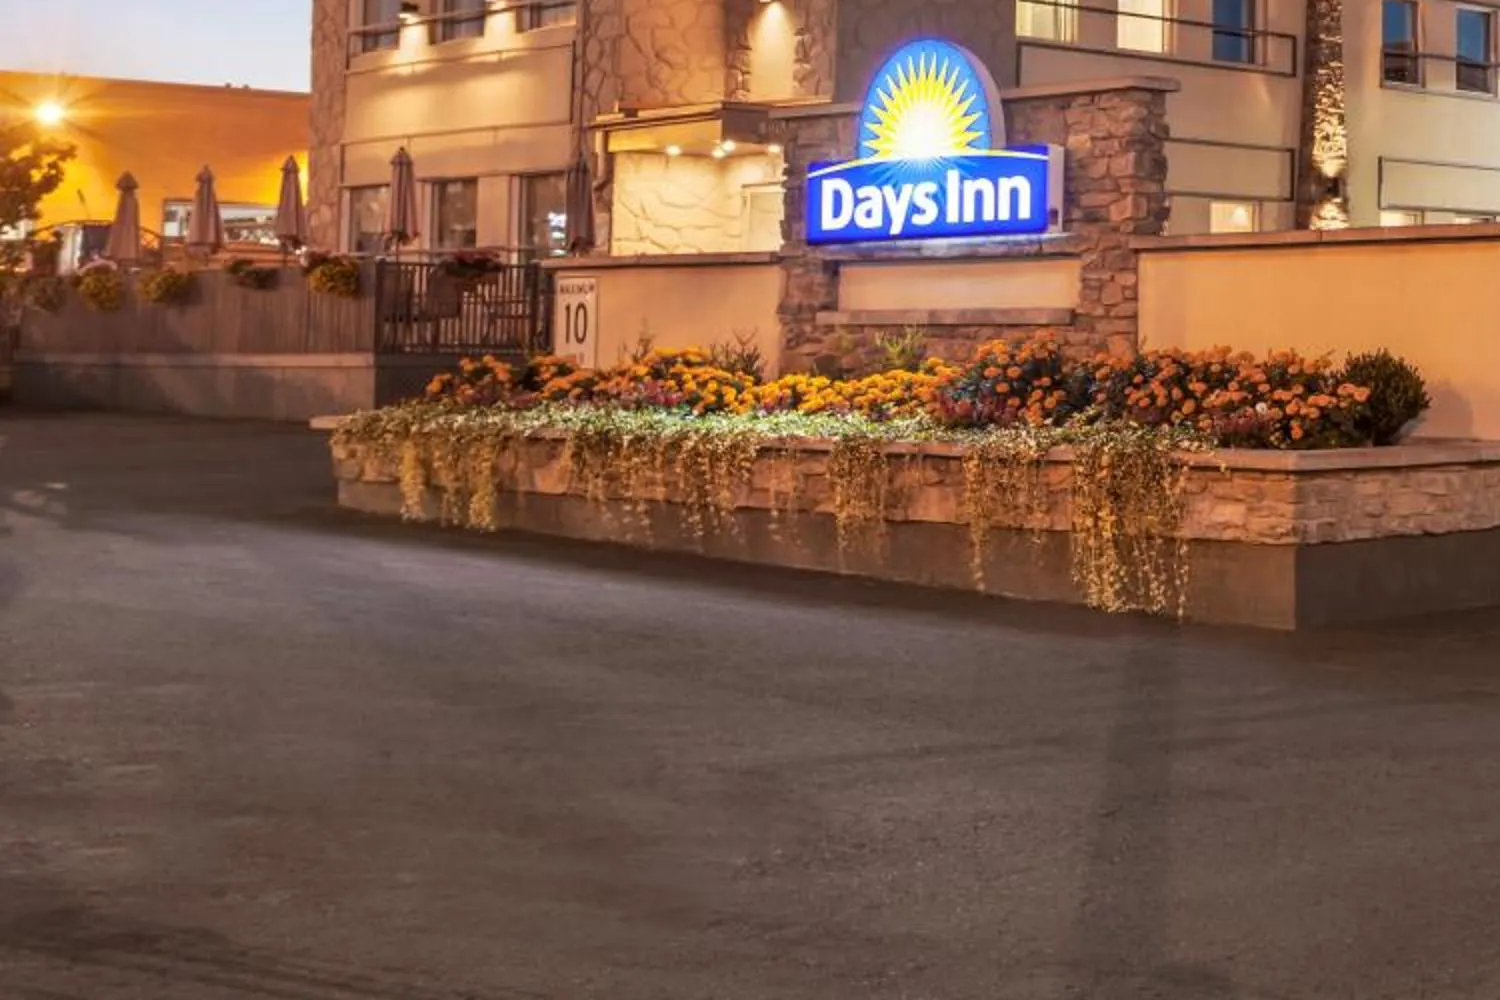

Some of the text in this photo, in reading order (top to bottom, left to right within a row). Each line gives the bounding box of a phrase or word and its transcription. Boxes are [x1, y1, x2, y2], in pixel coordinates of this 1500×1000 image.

[821, 169, 1032, 235] Days Inn
[565, 302, 588, 345] 10
